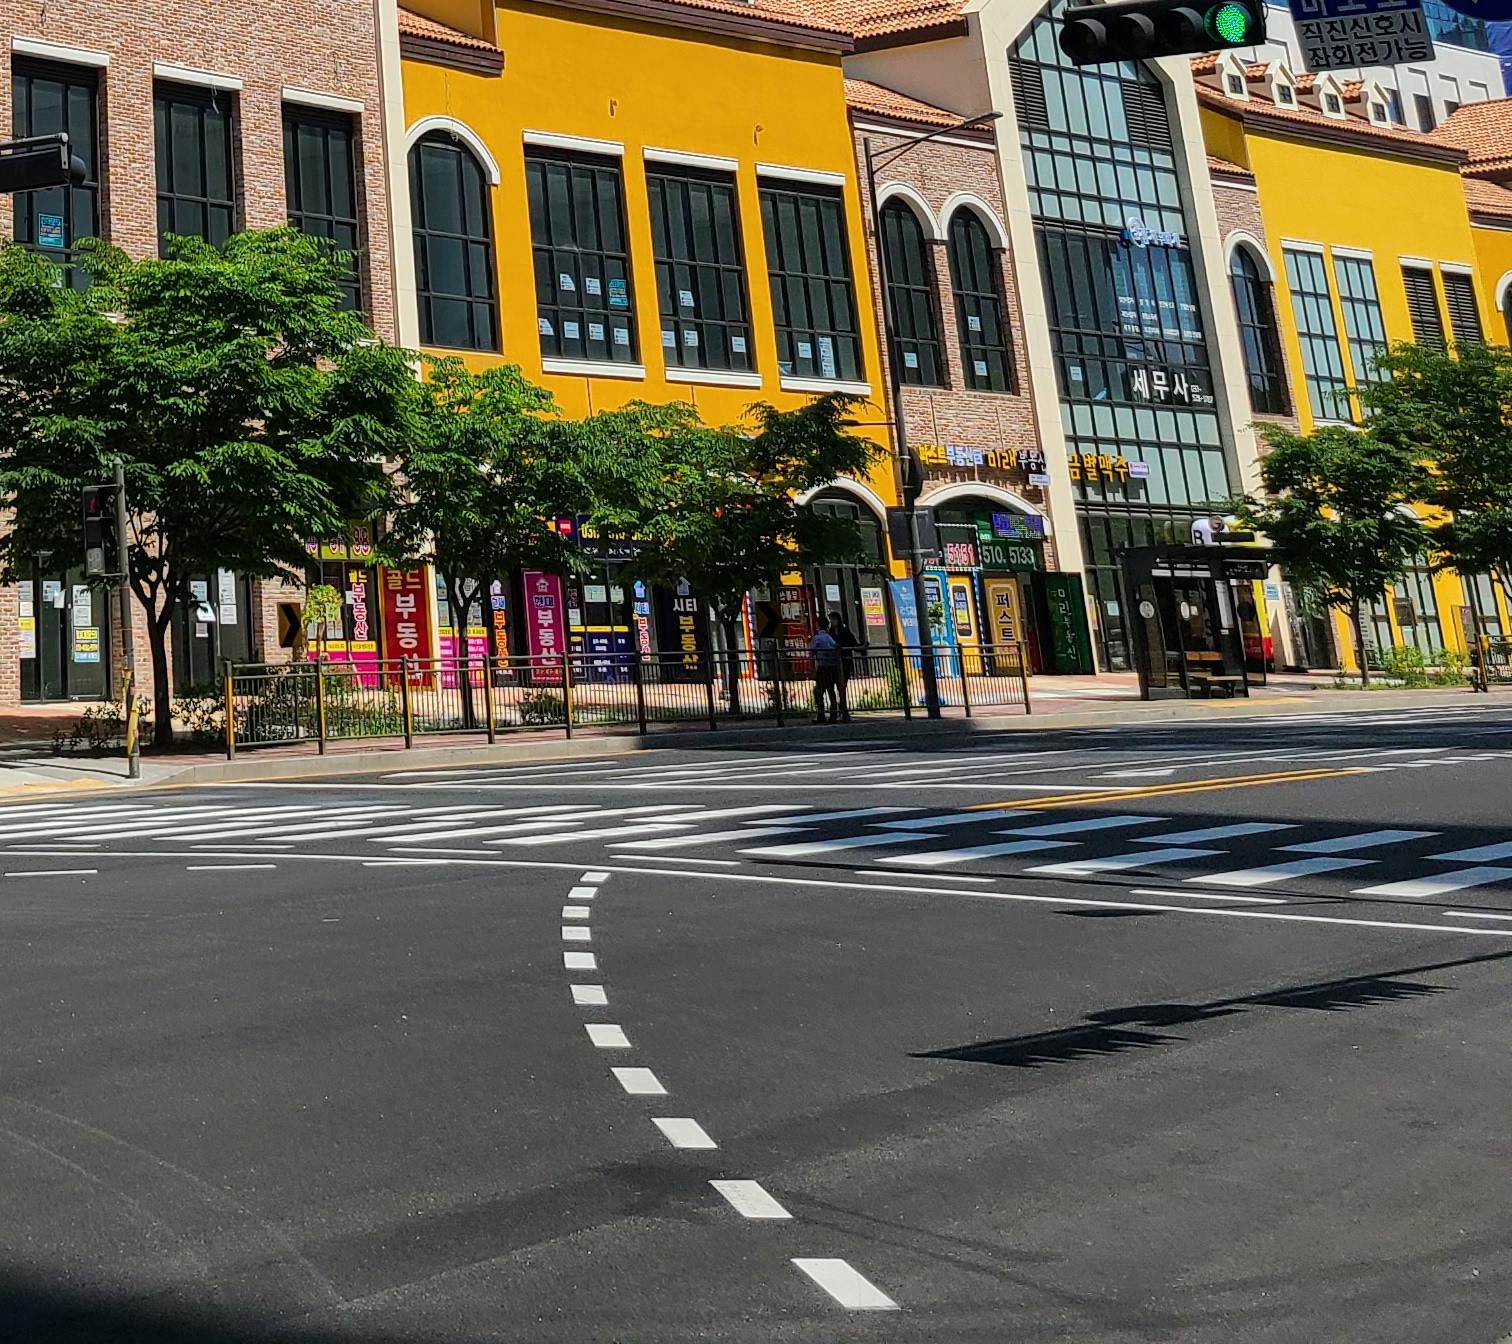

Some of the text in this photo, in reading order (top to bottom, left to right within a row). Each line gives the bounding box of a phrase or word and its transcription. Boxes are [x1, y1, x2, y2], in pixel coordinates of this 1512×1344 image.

[1301, 10, 1422, 44] 직진신호시
[1307, 37, 1428, 69] 좌회전가능
[1131, 369, 1189, 403] 세무사
[1067, 451, 1129, 483] 금별맥주
[386, 569, 422, 590] 골드
[352, 583, 369, 641] 부동산
[672, 597, 698, 612] 시티
[995, 592, 1016, 641] 퍼스트
[537, 609, 557, 665] 부동산
